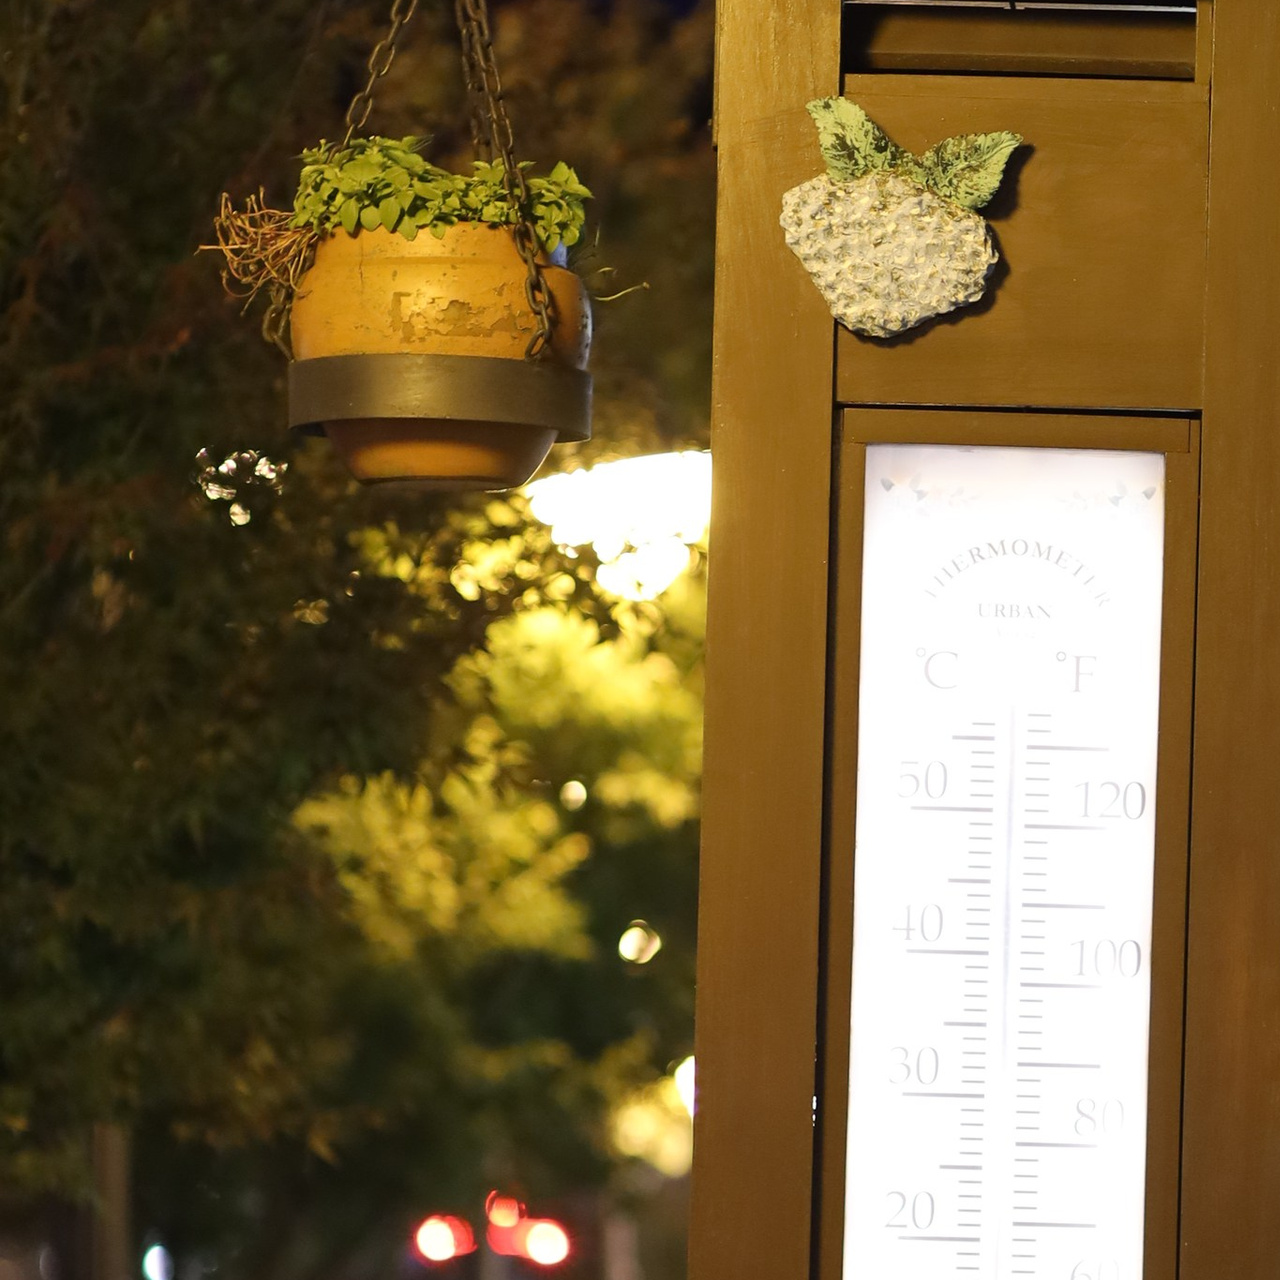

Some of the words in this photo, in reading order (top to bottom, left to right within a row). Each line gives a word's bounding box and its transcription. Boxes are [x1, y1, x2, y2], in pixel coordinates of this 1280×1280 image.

[977, 603, 1052, 620] URBAN
[896, 760, 948, 799] 50
[1074, 780, 1147, 820] 120
[892, 903, 944, 942] 40
[1069, 939, 1142, 978] 100
[888, 1046, 939, 1085] 30
[1073, 1097, 1125, 1137] 80
[884, 1190, 936, 1229] 20
